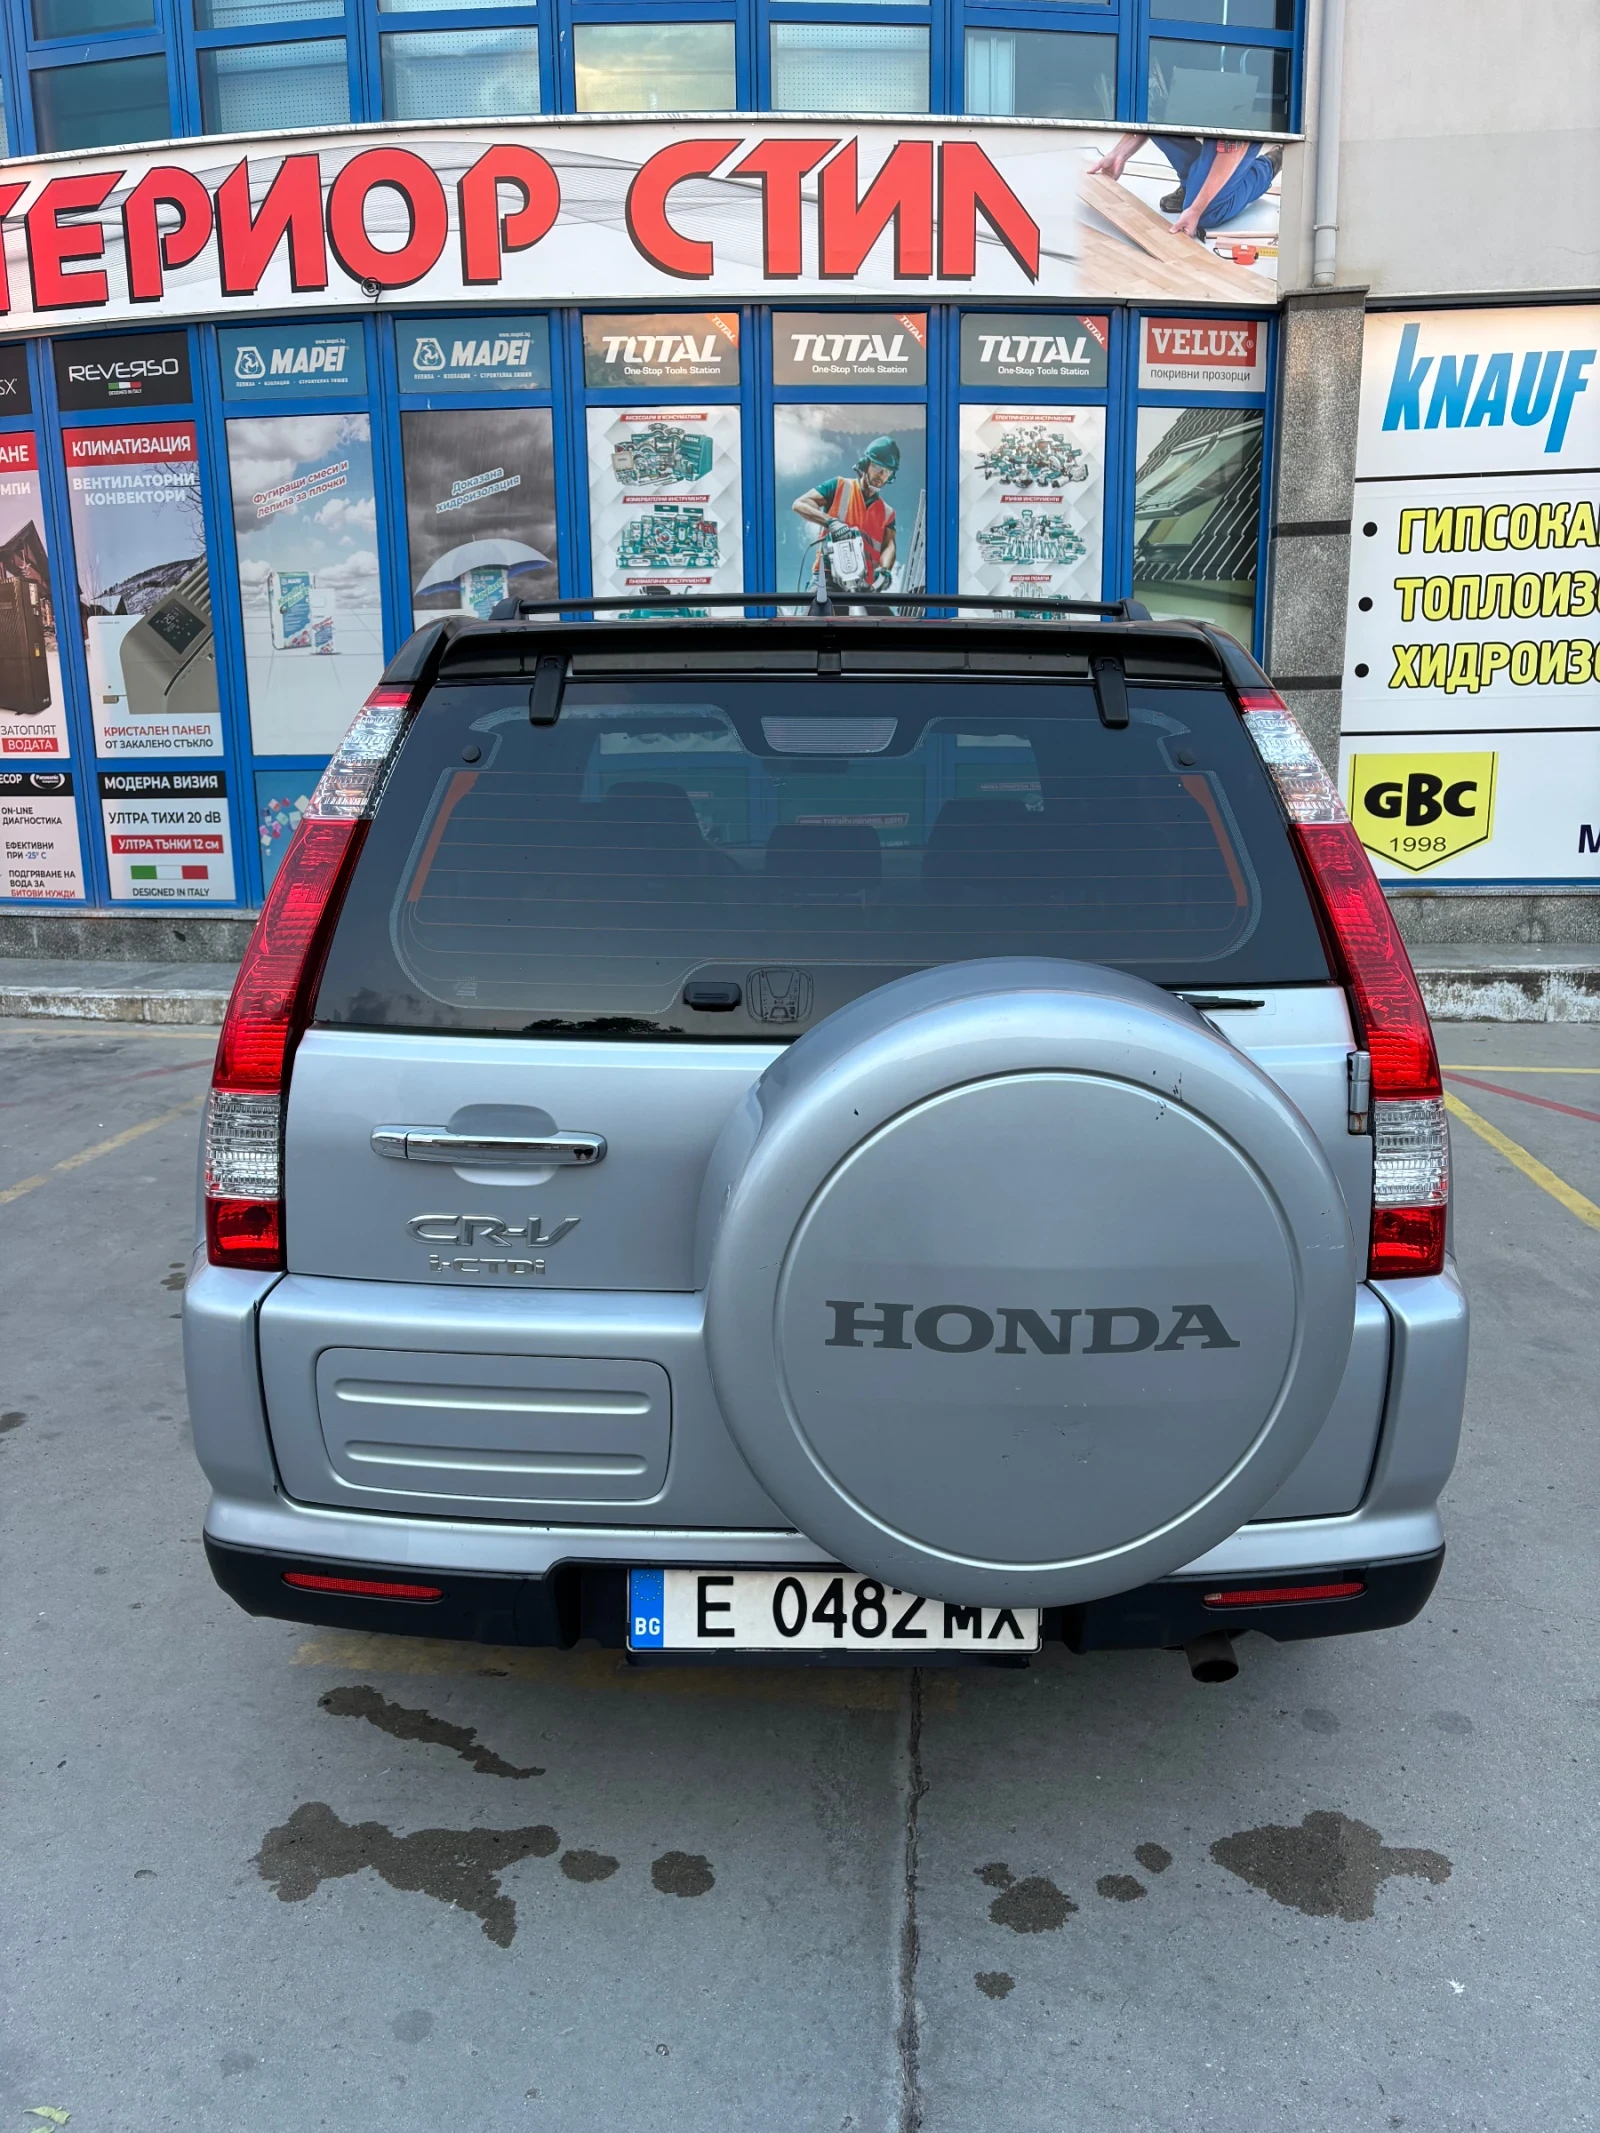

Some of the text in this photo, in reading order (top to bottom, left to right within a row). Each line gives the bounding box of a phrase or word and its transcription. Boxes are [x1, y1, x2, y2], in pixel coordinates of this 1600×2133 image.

[626, 136, 1040, 285] СТИЛ
[712, 315, 737, 342] TOTAL
[900, 315, 925, 342] TOTAL
[1083, 317, 1106, 344] TOTAL
[602, 335, 722, 363] TOTAL
[791, 334, 909, 361] TOTAL
[978, 335, 1091, 363] TOTAL
[1152, 328, 1248, 356] VELUX
[270, 346, 345, 374] MAPEI
[450, 340, 530, 366] MAPEI
[624, 365, 721, 376] One-Stop Tools Station
[812, 365, 908, 375] One-Stop Tools Station
[998, 366, 1090, 376] One-Stop Tools Station
[1150, 368, 1250, 382] покривни прозорци
[72, 436, 191, 457] КЛИМАТИЗАЦИЯ
[73, 473, 195, 491] ВЕНТИЛАТОРНИ
[253, 461, 348, 504] Фугиращи смеси и
[453, 468, 503, 494] Доказана
[85, 490, 186, 506] КОНВЕКТОРИ
[258, 476, 345, 517] лепила за плочки
[436, 476, 520, 513] хидроизолация
[1398, 501, 1600, 554] ГИПСОКА
[1394, 570, 1600, 622] ТОПЛОИЗ
[1388, 638, 1600, 694] ХИДРОИЗ
[0, 724, 57, 736] ЗАТОПЛЯТ
[104, 725, 211, 737] КРИСТАЛЕН ПАНЕЛ
[8, 739, 53, 752] ВОДАТА
[105, 738, 214, 749] ОТ ЗАКАЛЕНО СТЪКЛО
[104, 775, 219, 791] МОДЕРНА ВИЗИЯ
[1364, 773, 1477, 826] GBC
[1, 806, 34, 815] ON-LINE
[2, 816, 63, 826] ДИАГНОСТИКА
[108, 811, 221, 824] УЛТРА ТИХИ 20 dB
[5, 842, 54, 850] ЕФЕКТИВНИ
[118, 839, 154, 850] УЛТРА
[155, 839, 192, 849] ТЪНКИ
[193, 838, 203, 849] 12
[1389, 837, 1447, 852] 1998
[7, 851, 23, 860] ПРИ
[9, 870, 76, 879] ПОДГРЯВАНЕ НА
[10, 880, 45, 888] ВОДА ЗА
[11, 889, 76, 899] БИТОВИ НУЖДИ
[132, 888, 210, 897] DESIGNED IN ITALY
[406, 1215, 581, 1247] CR-V
[429, 1254, 546, 1275] i-CTDi
[825, 1300, 1241, 1355] HONDA
[634, 1617, 660, 1636] BG
[697, 1576, 735, 1638] E
[773, 1577, 927, 1639] 0482
